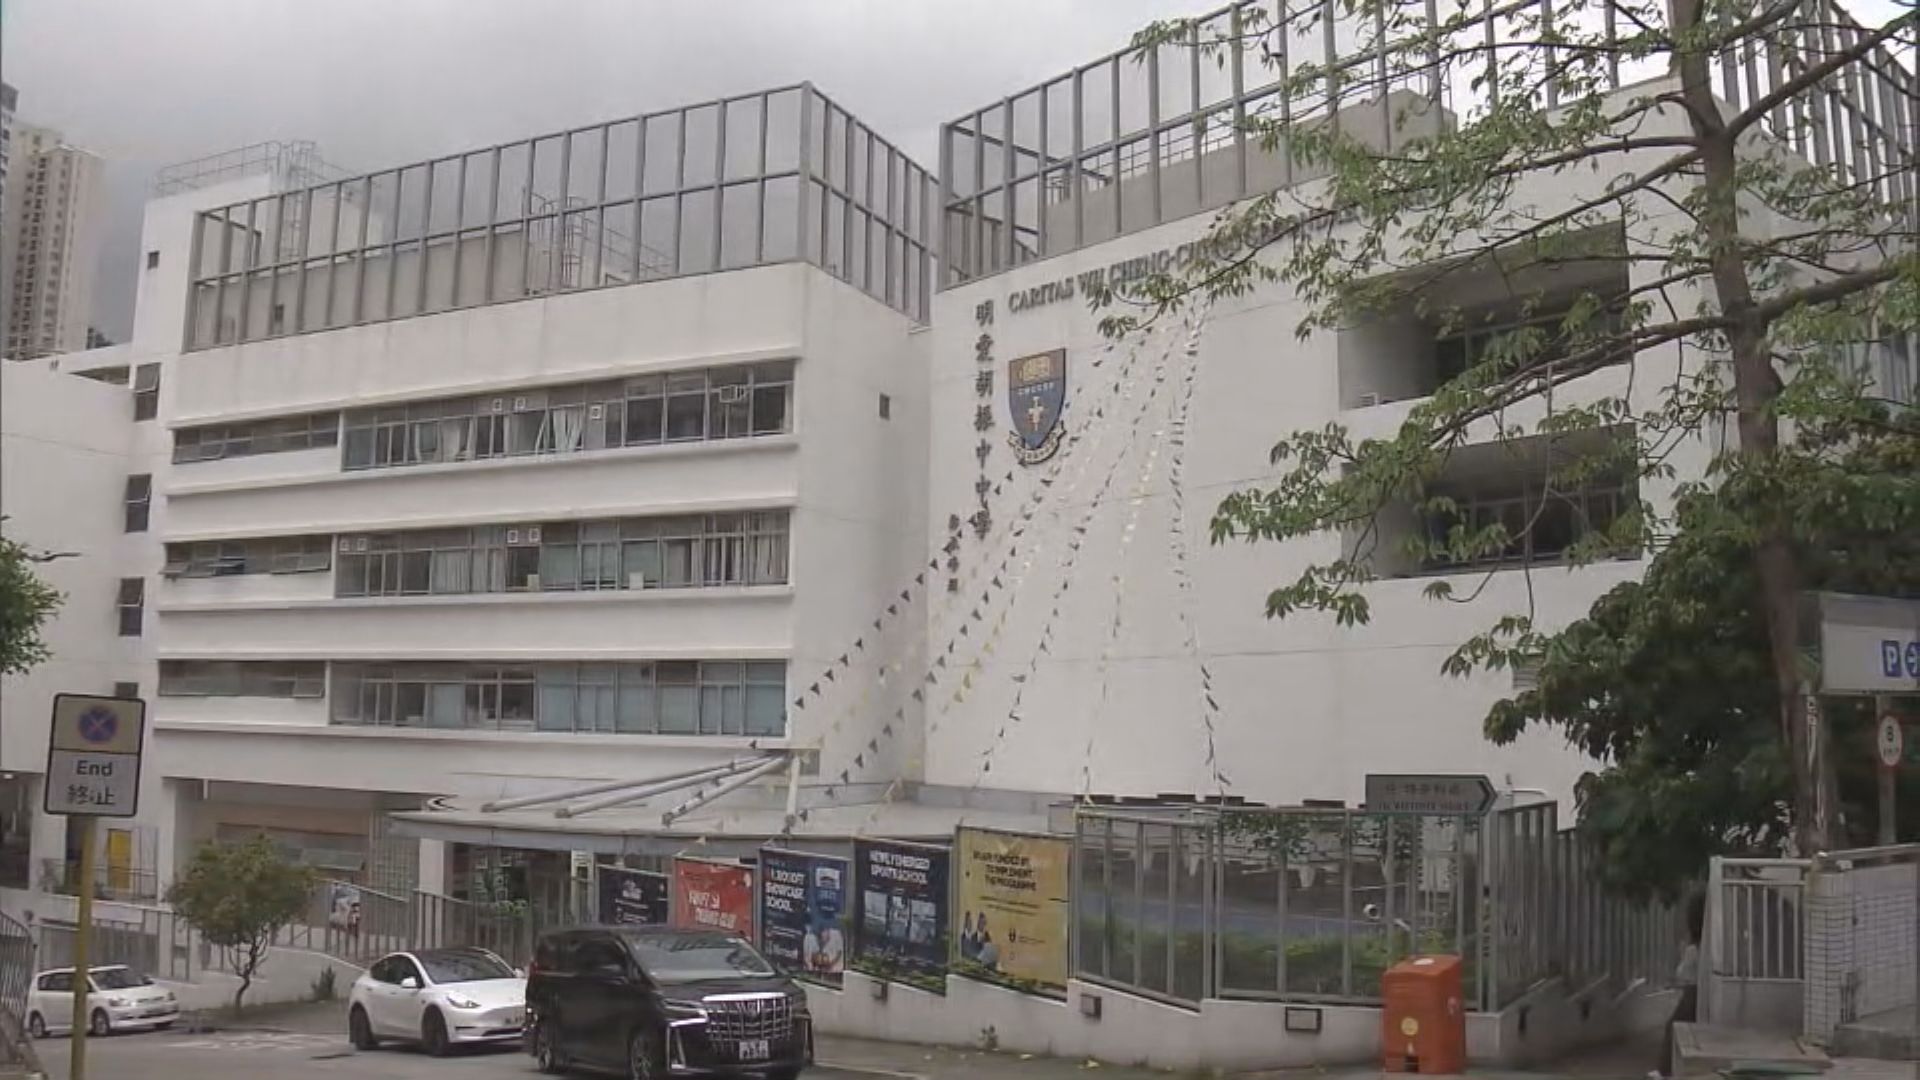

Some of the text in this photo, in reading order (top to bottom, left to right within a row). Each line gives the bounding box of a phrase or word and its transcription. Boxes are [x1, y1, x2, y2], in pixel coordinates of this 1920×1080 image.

[1008, 276, 1074, 313] CARITAS
[77, 760, 113, 776] End
[67, 784, 116, 806] 終止
